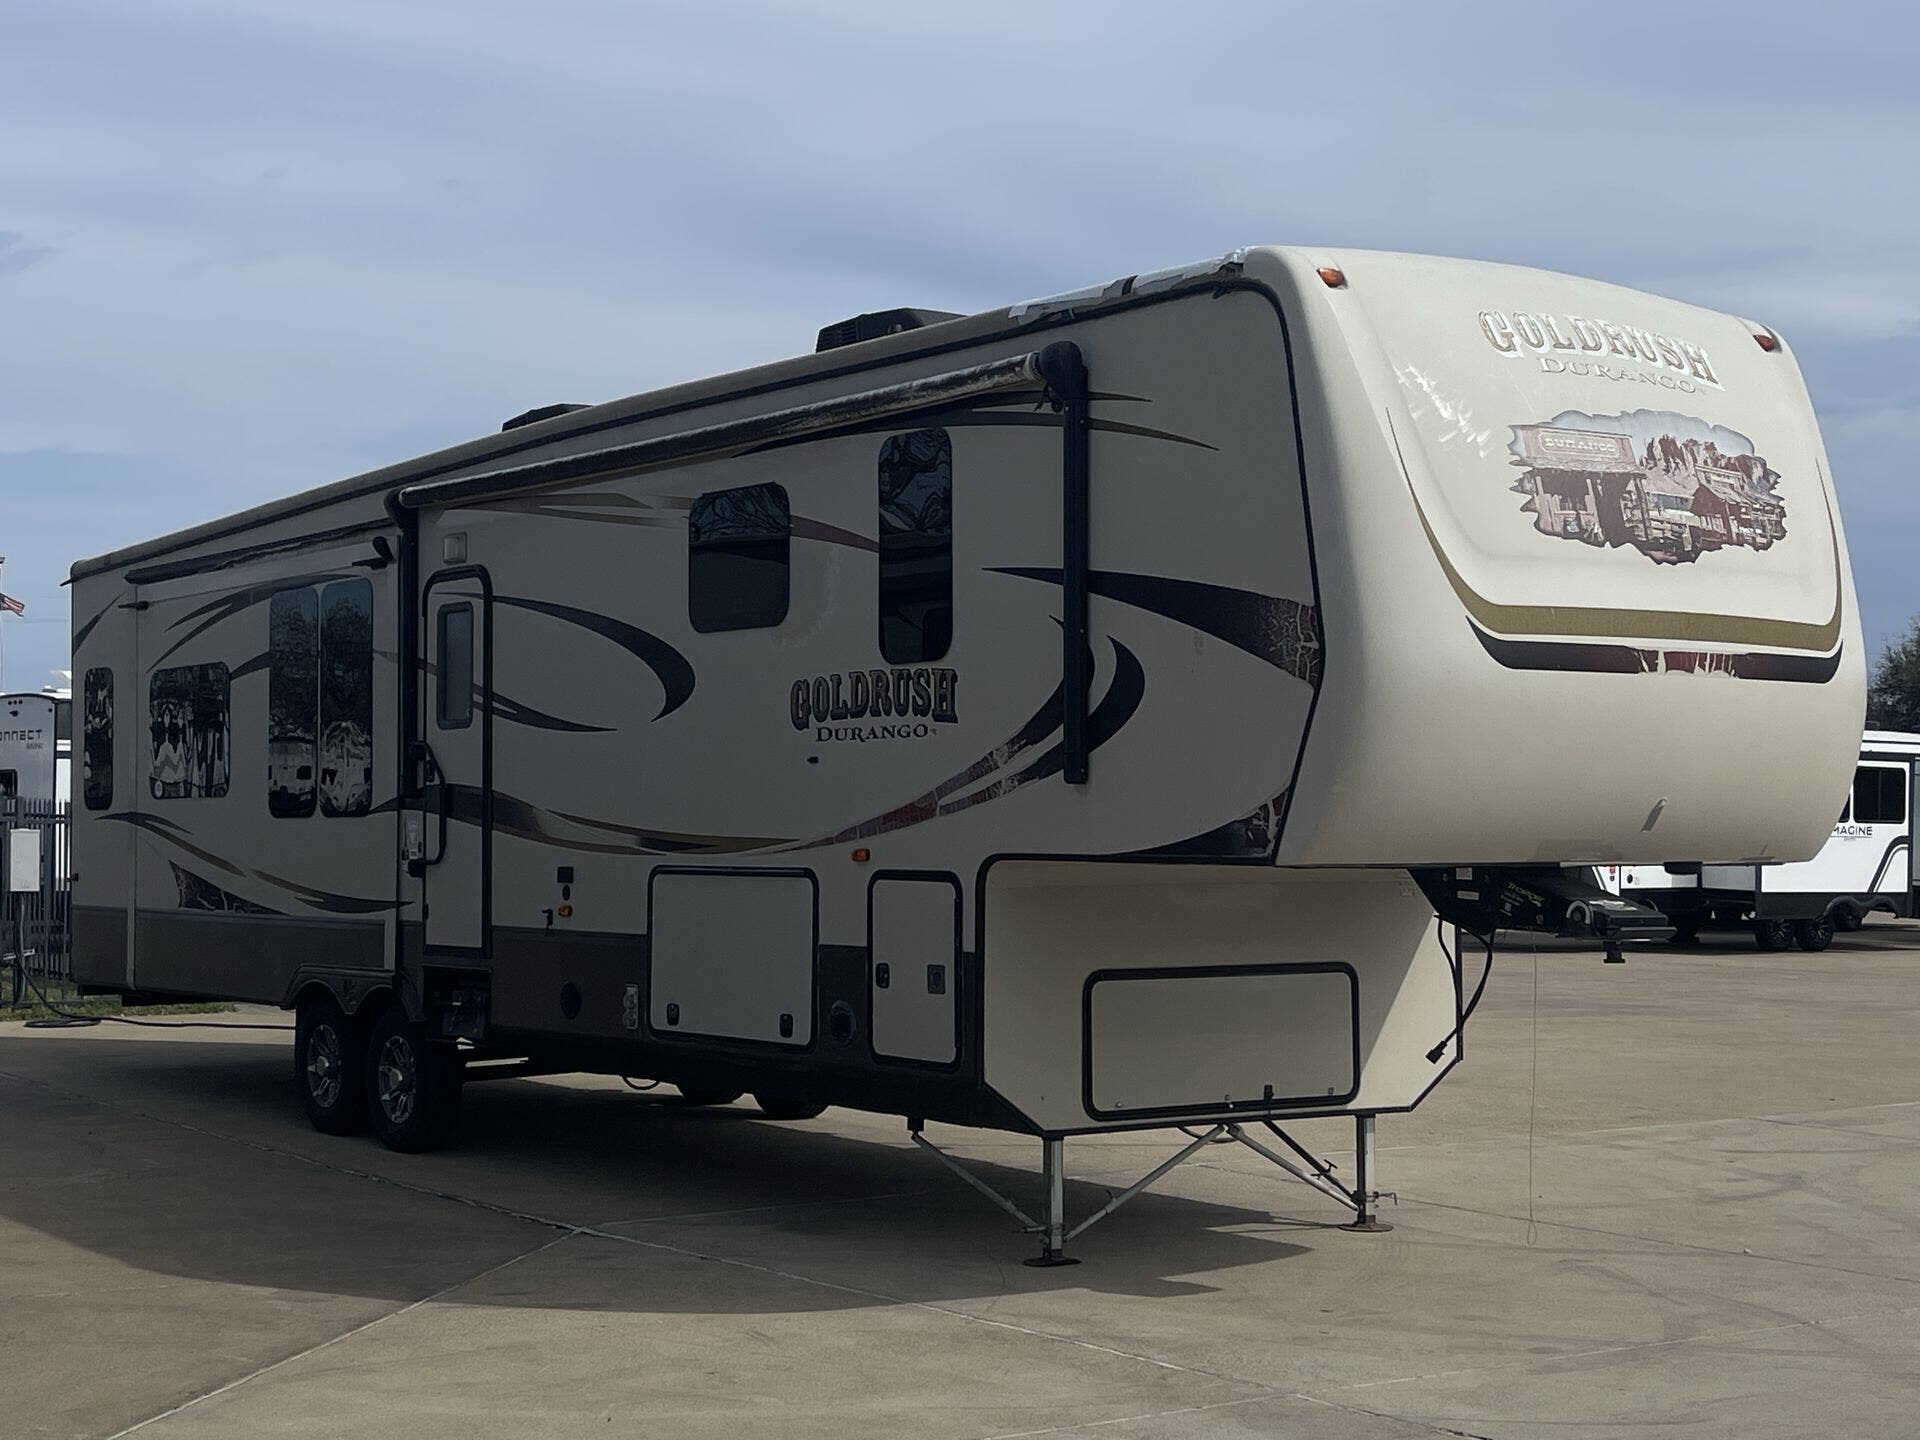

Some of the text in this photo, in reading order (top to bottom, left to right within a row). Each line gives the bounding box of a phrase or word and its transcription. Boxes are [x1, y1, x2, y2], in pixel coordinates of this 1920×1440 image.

[1478, 311, 1722, 388] GOLDRUSH
[1538, 356, 1697, 394] DURANGO
[790, 667, 958, 731] GOLDRUSH
[816, 723, 929, 743] DURANGO
